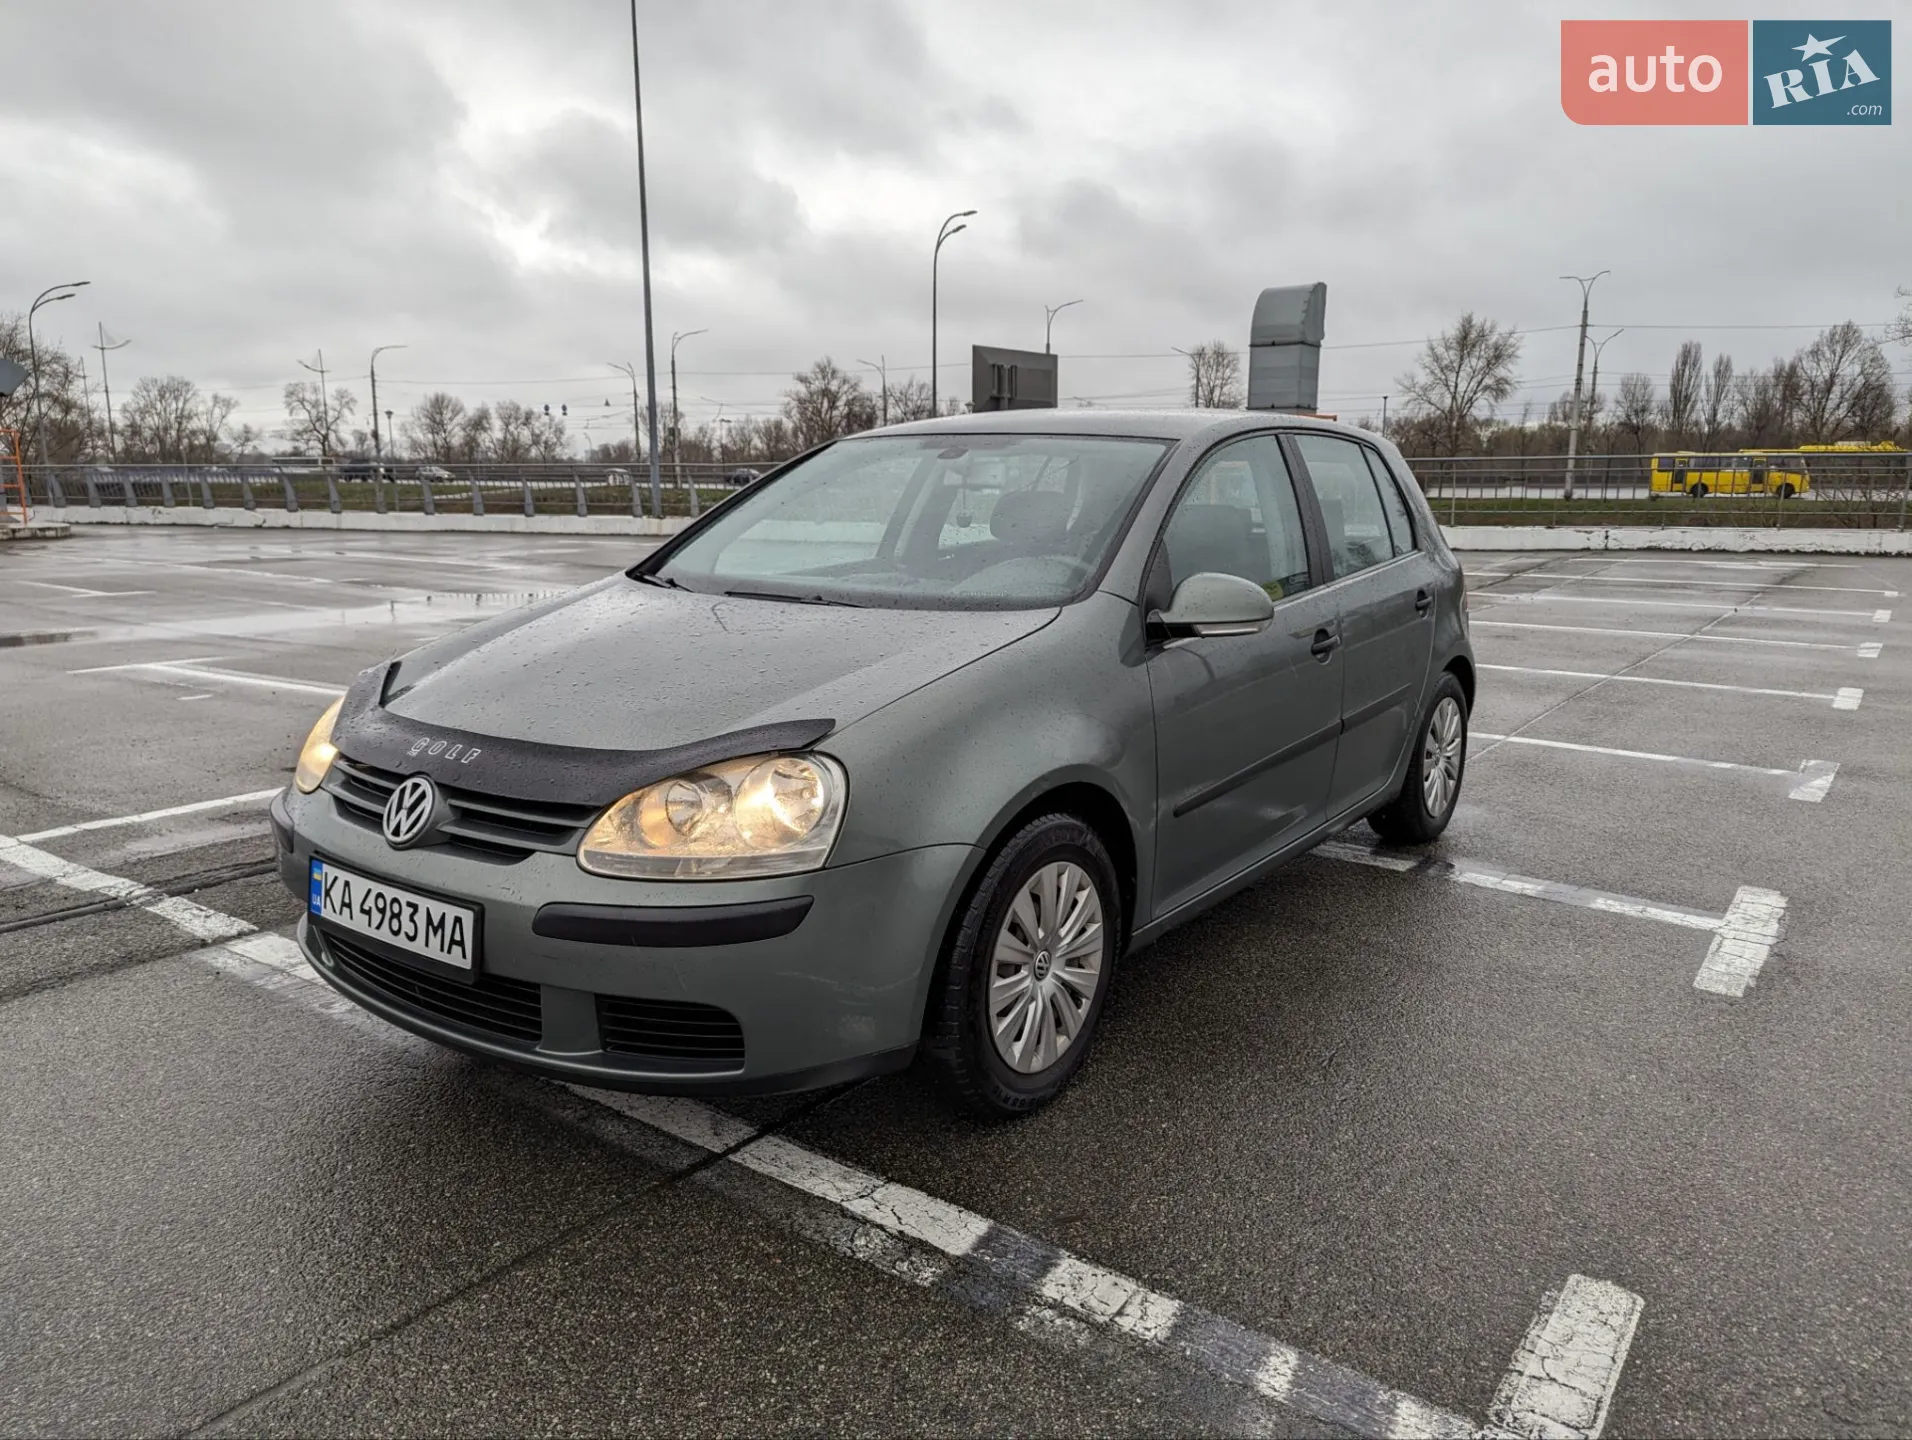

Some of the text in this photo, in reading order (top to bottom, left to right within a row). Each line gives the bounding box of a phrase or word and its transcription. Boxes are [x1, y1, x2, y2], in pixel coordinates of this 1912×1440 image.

[411, 737, 482, 763] GOLF
[323, 871, 467, 960] KA 4983 MA
